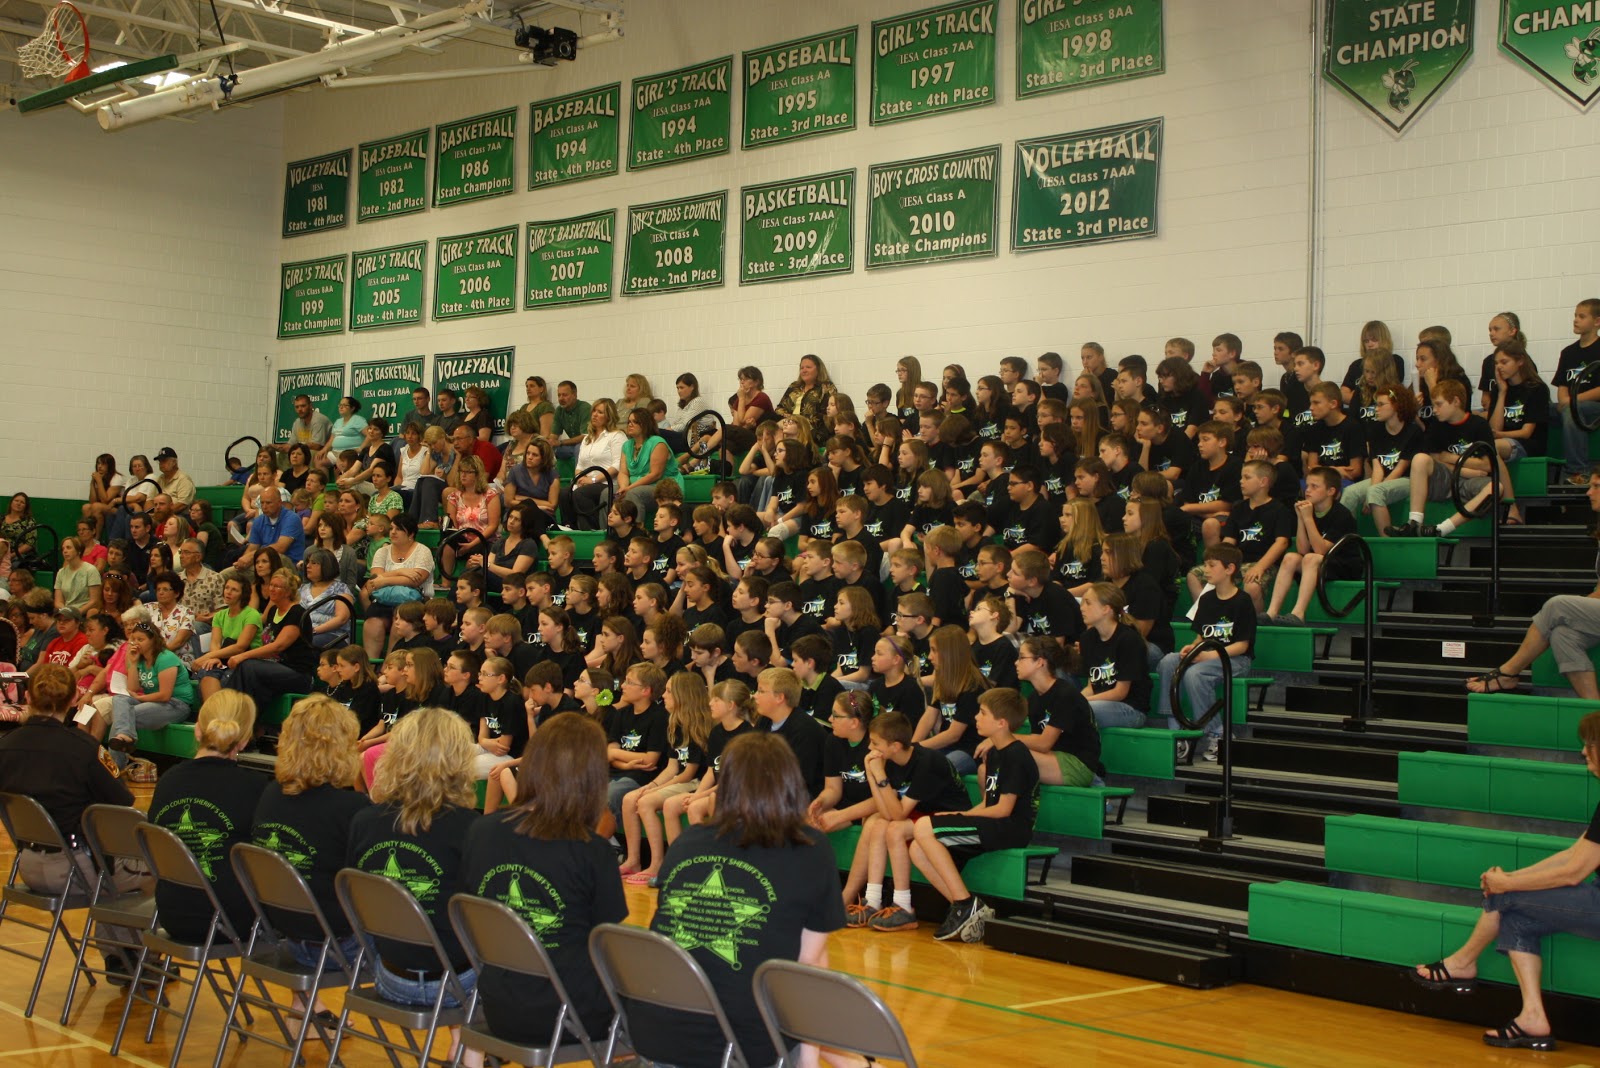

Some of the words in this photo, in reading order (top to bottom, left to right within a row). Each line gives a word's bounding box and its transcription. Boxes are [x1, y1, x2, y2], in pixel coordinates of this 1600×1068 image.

[1023, 0, 1082, 25] GIR
[1050, 19, 1071, 33] IESA
[1075, 13, 1103, 27] Class
[1108, 5, 1133, 19] 8AA
[1369, 1, 1435, 31] STATE
[878, 19, 930, 56] GIRL'S
[936, 5, 993, 35] TRACK
[900, 53, 919, 64] IESA
[923, 47, 948, 59] Class
[952, 40, 974, 53] 7AA
[1062, 29, 1112, 58] 1998
[1337, 24, 1466, 65] CHAMPION
[750, 38, 851, 86] BASEBALL
[1027, 72, 1062, 88] State
[1080, 61, 1104, 78] 3rd
[1111, 54, 1153, 72] Place
[771, 80, 788, 91] IESA
[791, 74, 814, 85] Class
[817, 70, 830, 79] AA
[912, 61, 955, 88] 1997
[636, 79, 678, 111] GIRL'S
[682, 66, 727, 92] TRACK
[653, 109, 668, 118] IESA
[671, 104, 691, 113] Class
[694, 97, 711, 108] 7AA
[778, 90, 817, 115] 1995
[880, 100, 912, 116] State
[926, 93, 948, 107] 4th
[953, 86, 989, 101] Place
[534, 93, 614, 134] BASEBALL
[441, 116, 514, 153] BASKETBALL
[567, 125, 584, 134] Class
[587, 120, 598, 129] AA
[662, 116, 696, 139] 1994
[750, 126, 778, 140] State
[791, 119, 809, 132] 3rd
[814, 113, 847, 127] Place
[362, 138, 426, 172] BASEBALL
[469, 146, 485, 154] Class
[487, 142, 502, 151] 7AA
[556, 138, 586, 160] 1994
[637, 149, 663, 162] State
[674, 143, 691, 155] 4th
[696, 137, 723, 151] Place
[1022, 131, 1155, 178] VOLLEYBALL
[290, 157, 348, 188] VOLLEYBALL
[387, 165, 402, 173] Class
[404, 162, 413, 170] AA
[461, 160, 489, 179] 1986
[535, 169, 557, 182] State
[567, 164, 581, 175] 4th
[586, 159, 612, 172] Place
[874, 169, 901, 198] BOY'S
[905, 163, 938, 185] CROSS
[942, 155, 994, 181] COUNTRY
[1043, 176, 1065, 188] IESA
[1069, 173, 1098, 184] Class
[1103, 165, 1135, 179] 7AAA
[380, 179, 404, 196] 1982
[441, 187, 461, 199] State
[464, 177, 511, 194] Champions
[904, 197, 923, 207] IESA
[926, 193, 954, 203] Class
[958, 190, 966, 199] A
[307, 196, 327, 213] 1981
[361, 206, 379, 216] State
[388, 200, 401, 210] 2nd
[404, 197, 424, 207] Place
[746, 180, 847, 221] BASKETBALL
[1060, 188, 1110, 216] 2012
[288, 222, 307, 231] State
[314, 218, 325, 226] 4th
[327, 213, 343, 223] Place
[633, 212, 652, 235] BOY'S
[656, 206, 681, 225] CROSS
[684, 199, 722, 220] COUNTRY
[762, 218, 780, 228] IESA
[783, 213, 806, 225] Class
[809, 210, 834, 222] 7AAA
[909, 211, 955, 235] 2010
[530, 226, 554, 252] GIRL'S
[557, 218, 611, 243] BASKETBALL
[670, 230, 690, 240] Class
[692, 228, 699, 237] A
[1023, 228, 1061, 242] State
[1077, 220, 1102, 236] 3rd
[1109, 217, 1148, 232] Place
[441, 240, 473, 266] GIRL'S
[477, 233, 514, 256] TRACK
[557, 248, 574, 258] Class
[577, 246, 599, 255] 7AAA
[773, 230, 817, 253] 2009
[874, 243, 909, 256] State
[915, 233, 987, 253] Champions
[357, 254, 386, 279] GIRL'S
[389, 249, 422, 271] TRACK
[468, 263, 485, 271] Class
[487, 259, 501, 269] 8AA
[656, 246, 693, 267] 2008
[748, 262, 775, 274] State
[789, 255, 808, 269] 3rd
[286, 266, 312, 290] GIRL'S
[314, 262, 343, 282] TRACK
[380, 276, 395, 284] Class
[397, 273, 410, 282] 7AA
[551, 261, 584, 281] 2007
[631, 277, 658, 288] State
[668, 271, 687, 284] 2nd
[691, 269, 717, 282] Place
[460, 276, 491, 294] 2006
[531, 289, 553, 300] State
[557, 283, 608, 297] Champions
[301, 300, 324, 316] 1999
[373, 289, 400, 306] 2005
[441, 303, 463, 314] State
[471, 299, 485, 309] 4th
[488, 297, 510, 307] Place
[284, 322, 301, 332] State
[304, 318, 342, 329] Champions
[357, 314, 374, 324] State
[382, 311, 394, 320] 4th
[397, 308, 417, 319] Place
[297, 374, 314, 388] CROSS
[315, 371, 341, 388] COUNTRY
[355, 368, 373, 387] GIRLS
[375, 364, 420, 382] BASKETBALL
[438, 355, 511, 382] VOLLEYBALL
[394, 387, 410, 395] 7AAA
[481, 380, 500, 388] 8AAA
[372, 402, 397, 418] 2012
[170, 798, 193, 808] COUNTY
[218, 812, 235, 831] OFFICE
[373, 841, 399, 851] COUNTY
[426, 856, 444, 876] OFFICE
[496, 864, 523, 873] COUNTY
[693, 856, 728, 864] COUNTY
[760, 877, 777, 902] OFFICE
